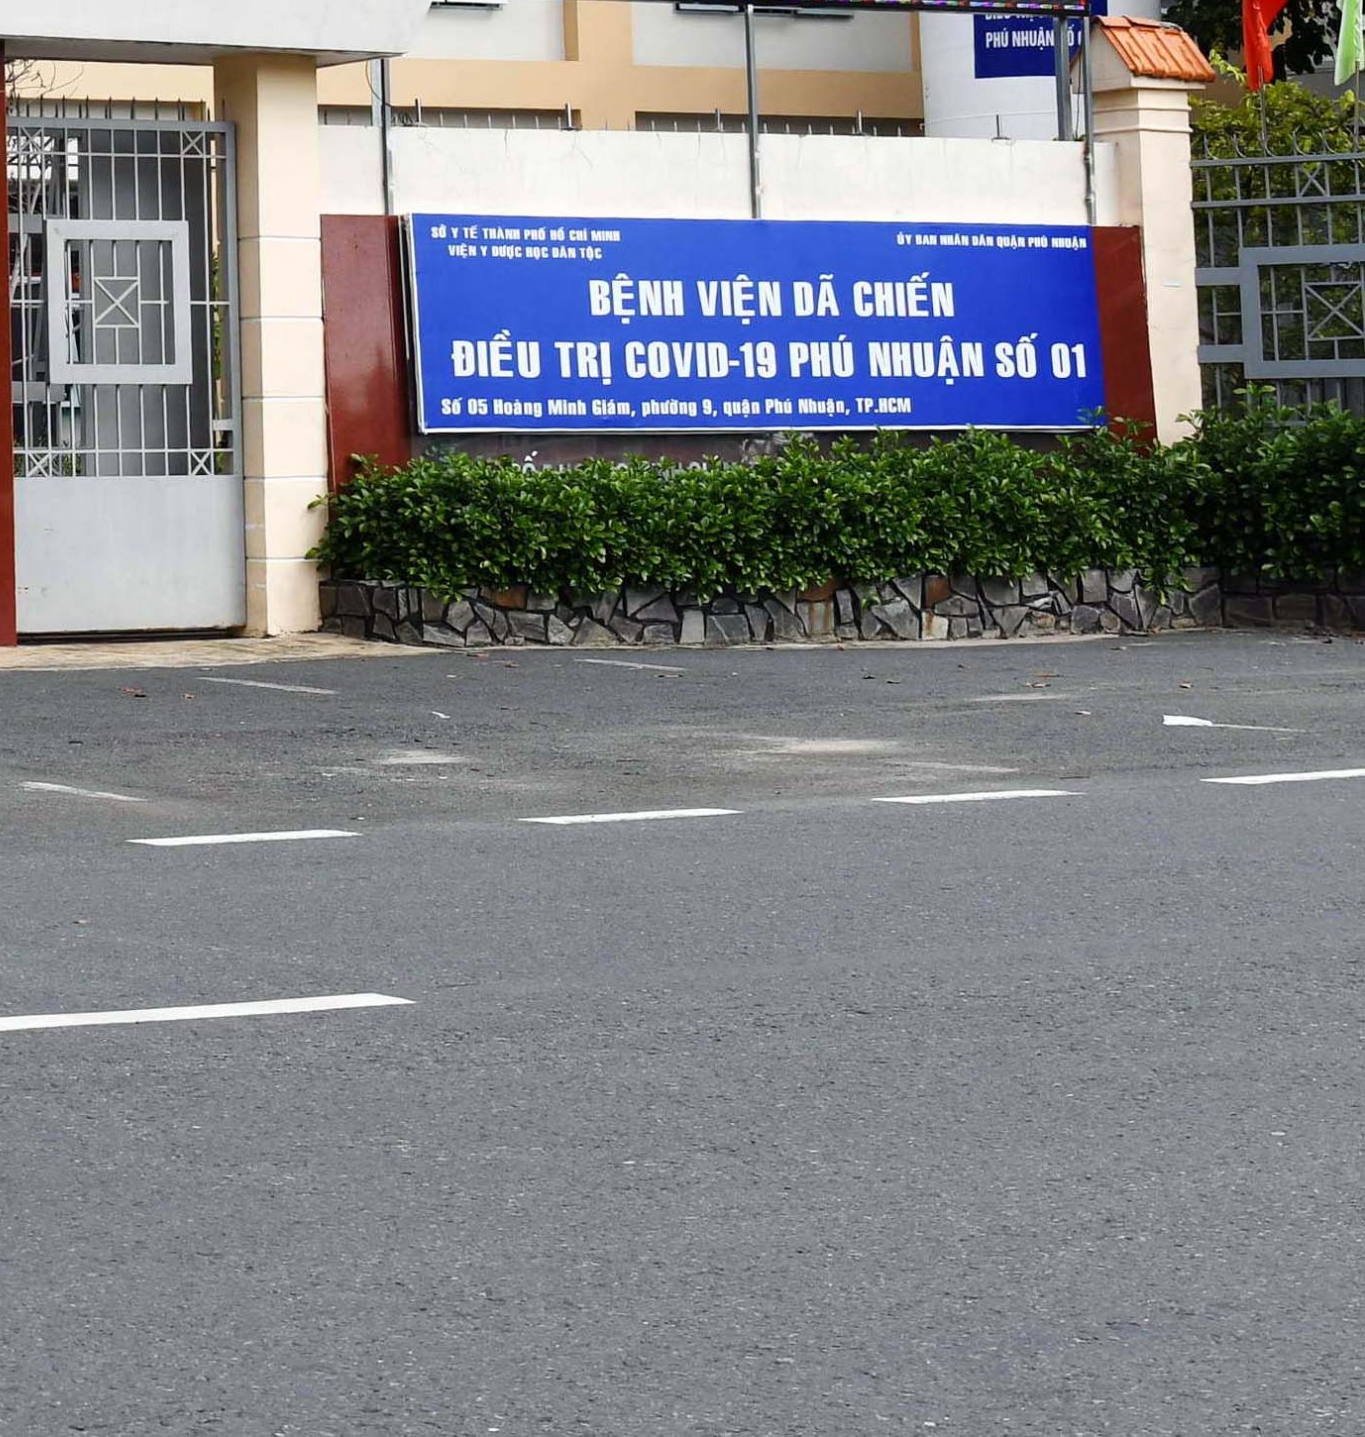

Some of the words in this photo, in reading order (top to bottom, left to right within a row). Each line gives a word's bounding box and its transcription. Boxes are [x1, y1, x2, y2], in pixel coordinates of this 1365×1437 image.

[985, 27, 1009, 48] PHÚ
[1012, 26, 1054, 51] NHUẬN
[451, 227, 459, 239] Y
[463, 225, 478, 240] TẾ
[482, 225, 520, 241] THÀNH
[524, 225, 546, 241] PHỐ
[591, 230, 621, 242] MINH
[915, 234, 937, 246] BAN
[940, 232, 969, 247] NHÂN
[972, 233, 994, 248] DÂN
[997, 234, 1025, 251] QUẬN
[1051, 235, 1087, 251] NHUẬN
[448, 243, 476, 259] VIỆN
[480, 245, 488, 258] Y
[492, 243, 522, 260] DƯỢC
[526, 245, 549, 261] HỌC
[552, 244, 577, 260] DÂN
[579, 244, 603, 262] TỘC
[588, 272, 685, 325] BỆNH
[696, 273, 783, 325] VIỆN
[793, 273, 840, 317] DÃ
[853, 271, 956, 318] CHIẾN
[451, 329, 541, 378] ĐIỀU
[554, 340, 612, 385] TRỊ
[625, 340, 777, 379] COVID-19
[789, 334, 855, 378] PHÚ
[868, 335, 985, 385] NHUẬN
[994, 332, 1039, 379] SỐ
[1050, 342, 1087, 379] 01
[440, 397, 462, 416] Số
[467, 399, 488, 415] 05
[493, 398, 542, 418] Hoàng
[547, 398, 587, 416] Minh
[591, 397, 636, 418] Giám,
[641, 397, 697, 417] phường
[702, 398, 718, 417] 9,
[723, 399, 760, 418] quận
[765, 397, 793, 415] Phú
[798, 397, 850, 418] Nhuận,
[856, 397, 911, 414] TP.HCM
